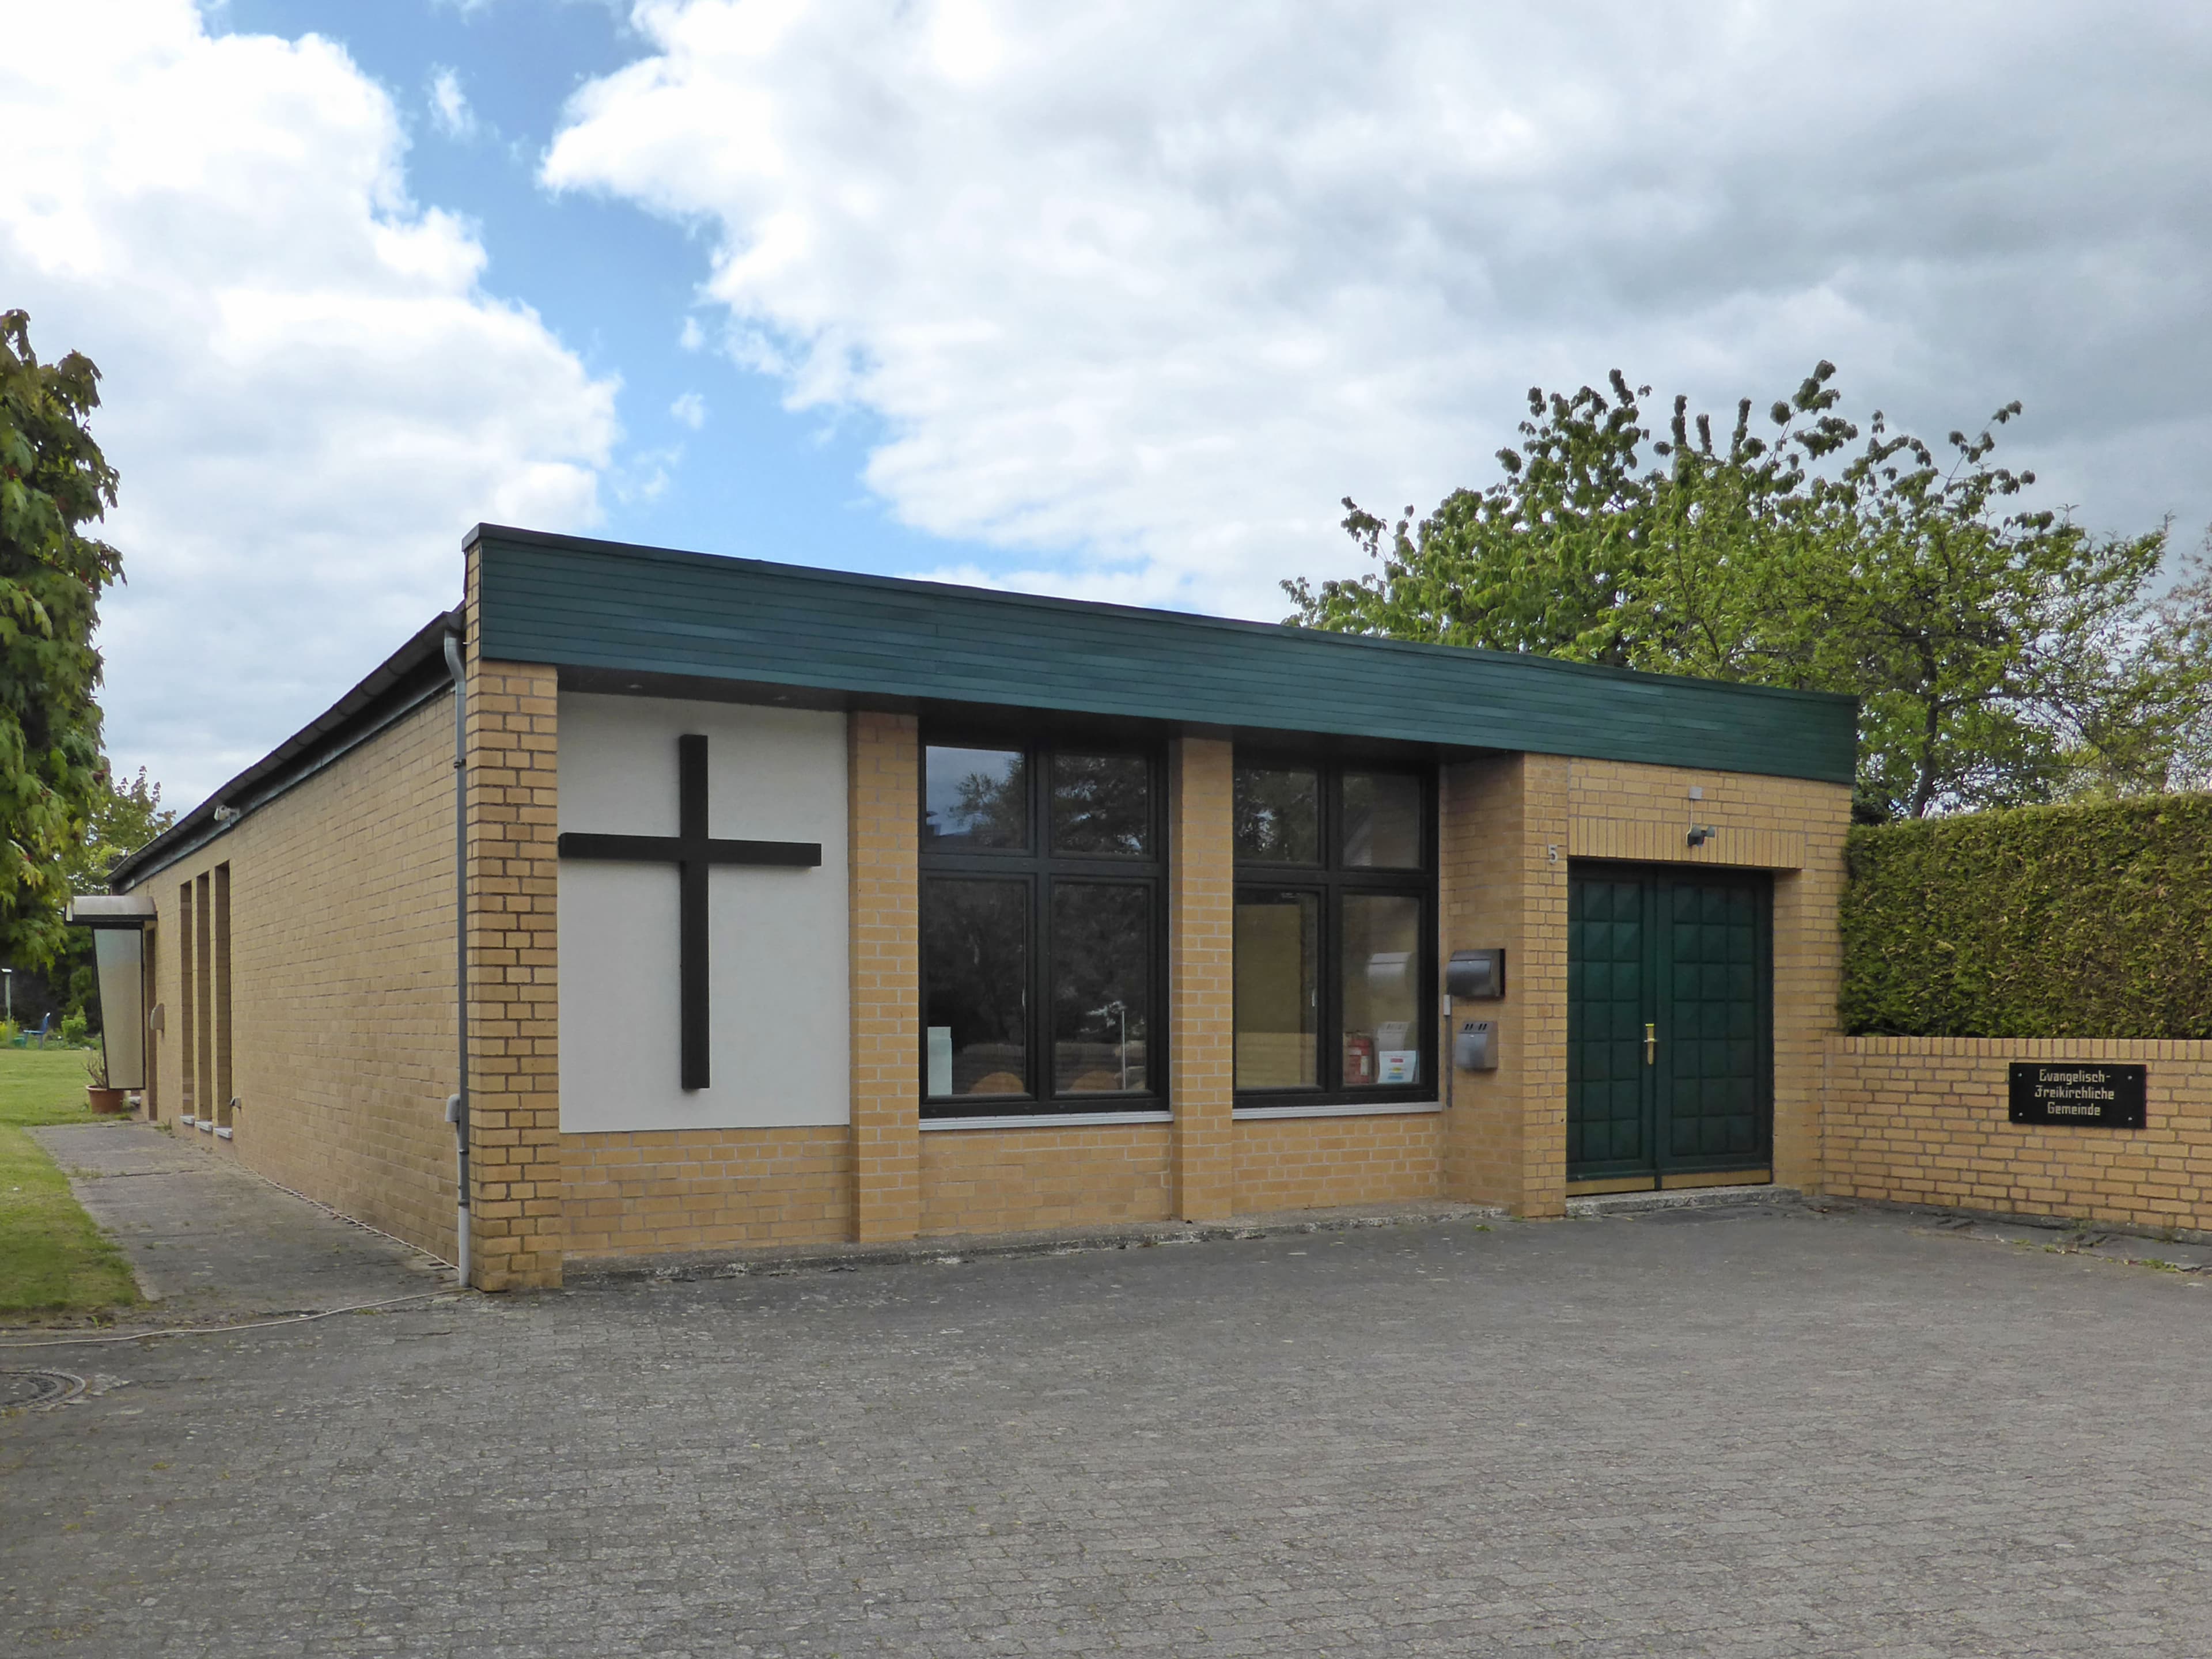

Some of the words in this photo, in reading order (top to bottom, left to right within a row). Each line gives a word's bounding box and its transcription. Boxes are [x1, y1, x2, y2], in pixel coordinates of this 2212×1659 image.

[1548, 844, 1558, 864] 5
[2039, 1069, 2111, 1085] Evangelisch-
[2035, 1085, 2115, 1100] Freikirchliche
[2047, 1101, 2101, 1116] Gemeinde
